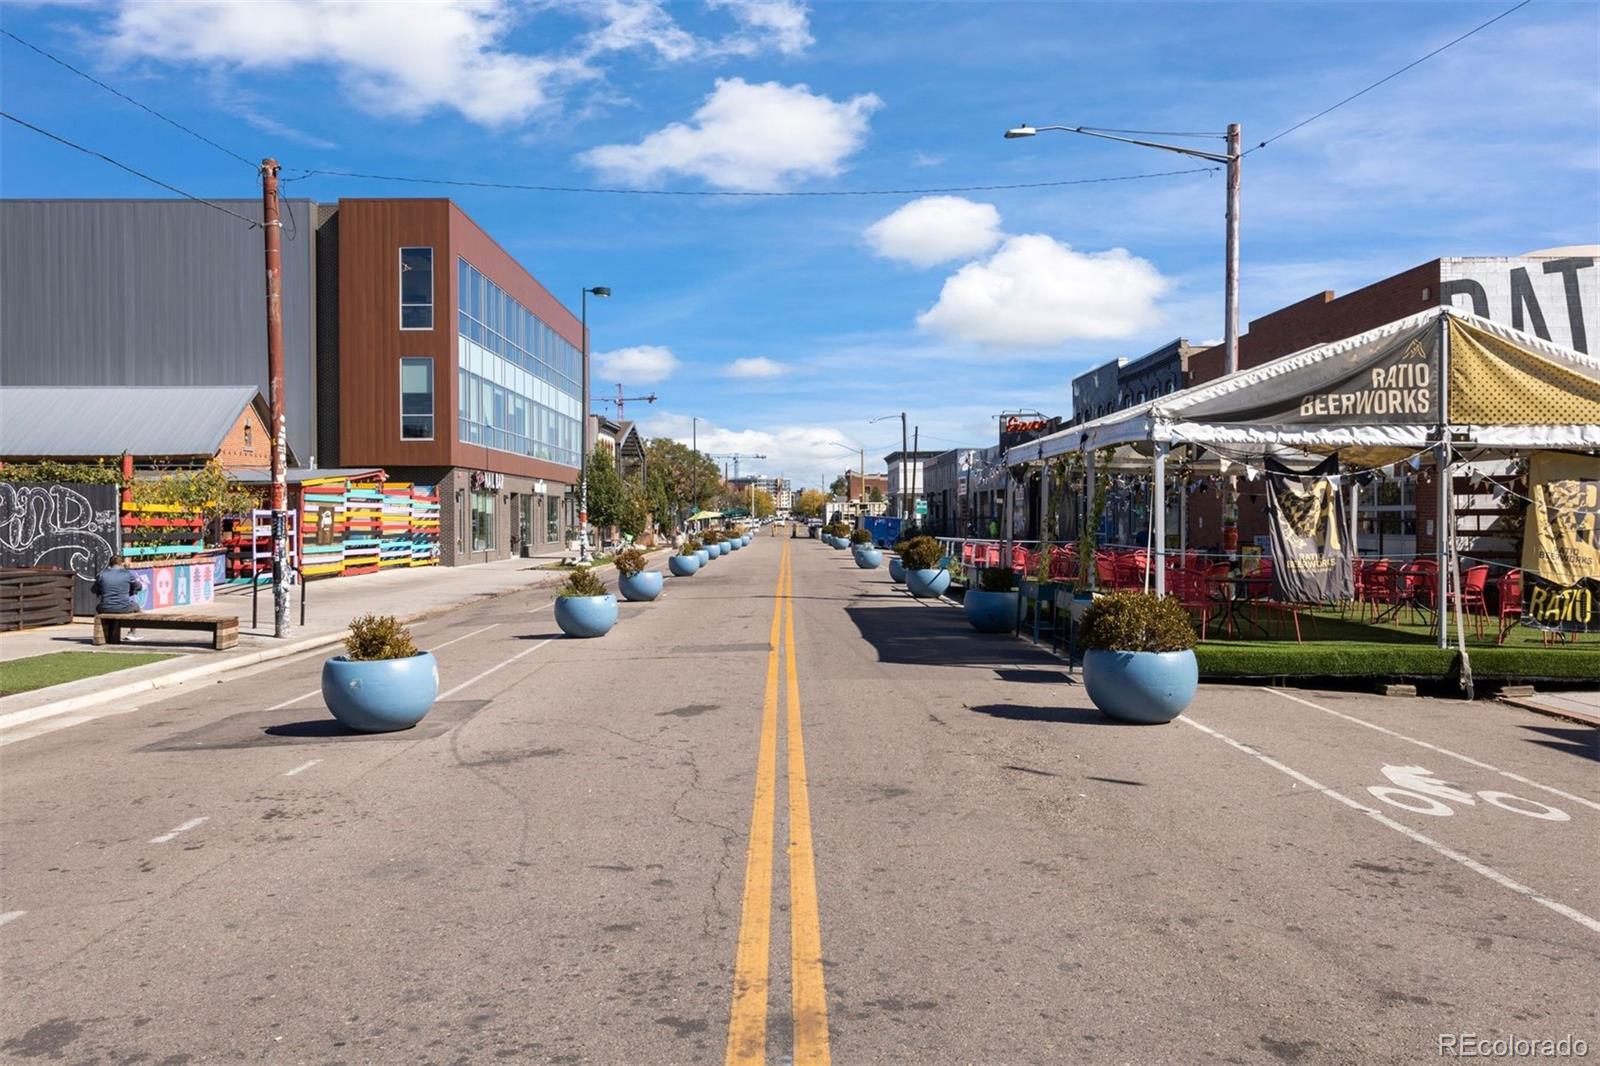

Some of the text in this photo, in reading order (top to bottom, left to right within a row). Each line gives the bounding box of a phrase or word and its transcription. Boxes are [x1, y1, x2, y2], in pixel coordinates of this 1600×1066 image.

[1372, 363, 1430, 389] RATIO
[1300, 389, 1430, 417] BEERWORKS
[1528, 584, 1592, 624] RATIO
